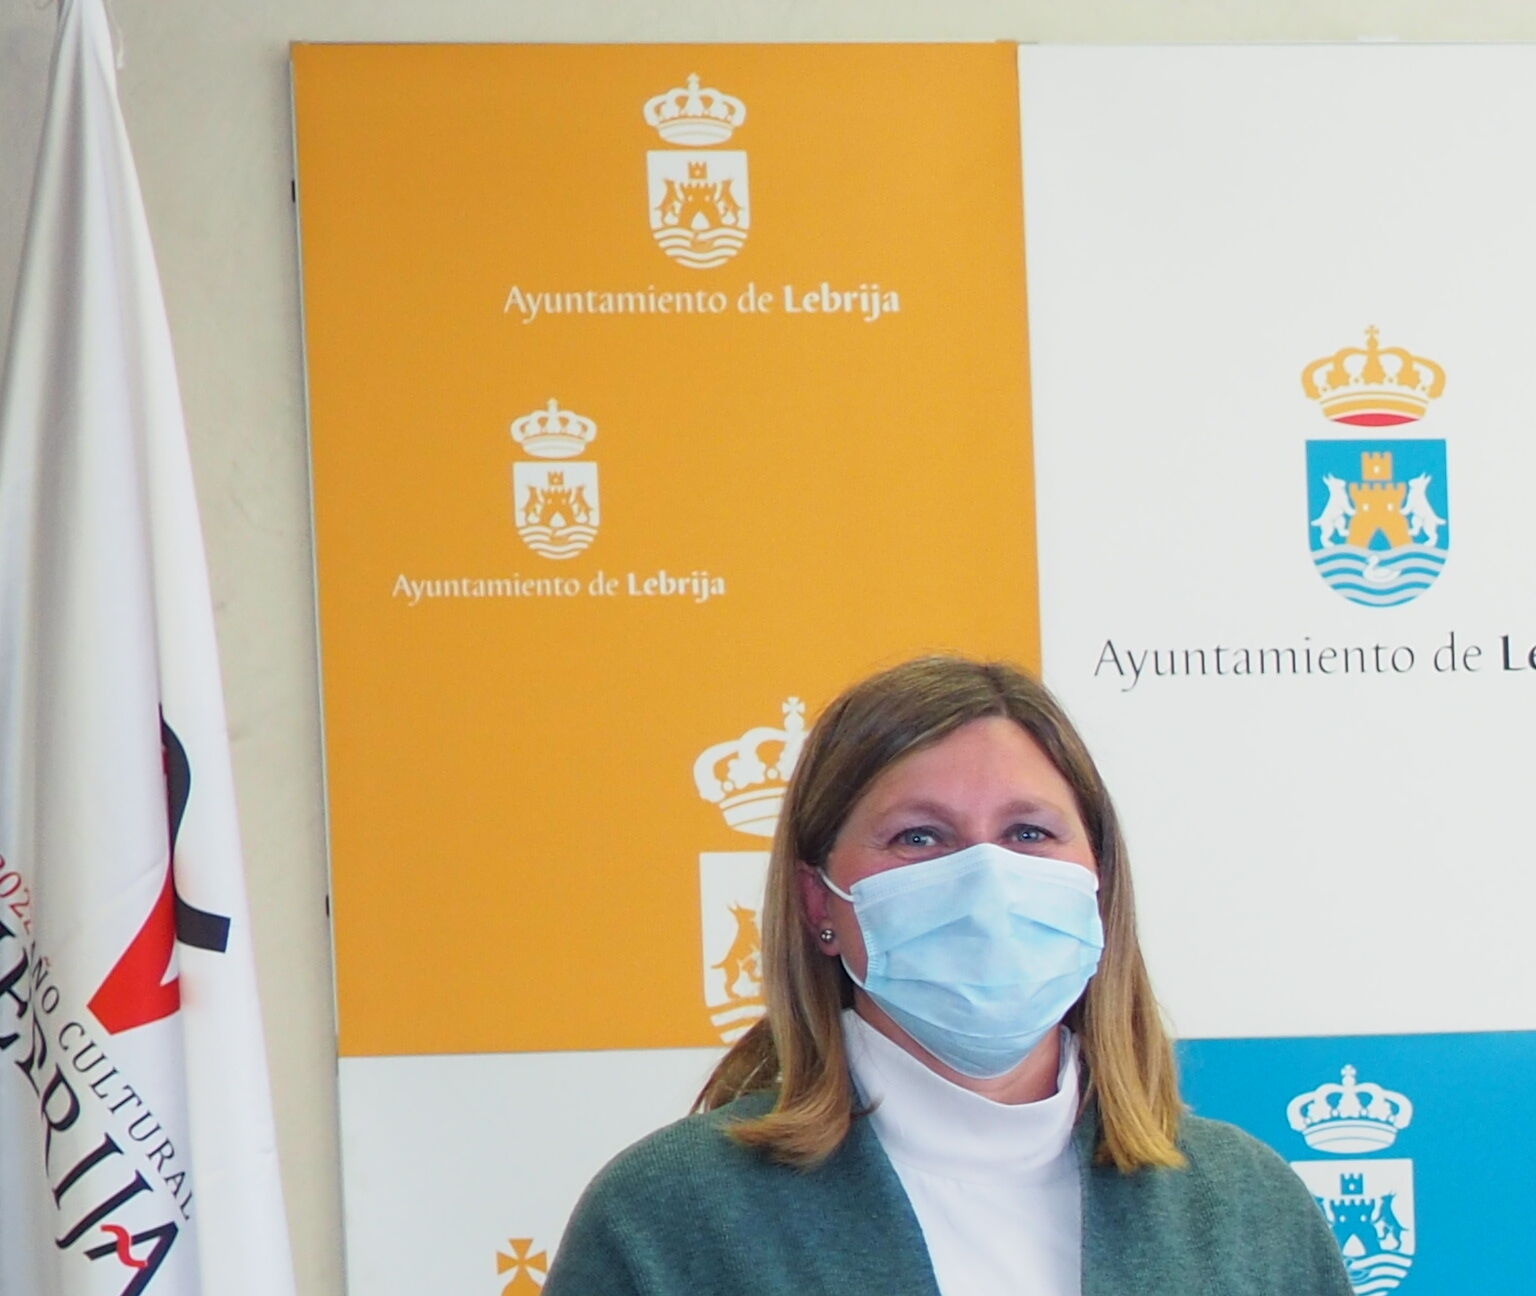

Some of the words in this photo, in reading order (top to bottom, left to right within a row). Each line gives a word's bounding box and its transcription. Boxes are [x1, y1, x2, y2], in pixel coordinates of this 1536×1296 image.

[503, 284, 729, 325] Ayuntamiento
[737, 282, 774, 314] de
[784, 282, 901, 323] Lebrija
[391, 572, 581, 607] Ayuntamiento
[588, 570, 619, 597] de
[626, 569, 726, 604] Lebrija
[1093, 635, 1416, 692] Ayuntamiento
[1432, 630, 1483, 673] de
[58, 1021, 194, 1221] CULTURAL
